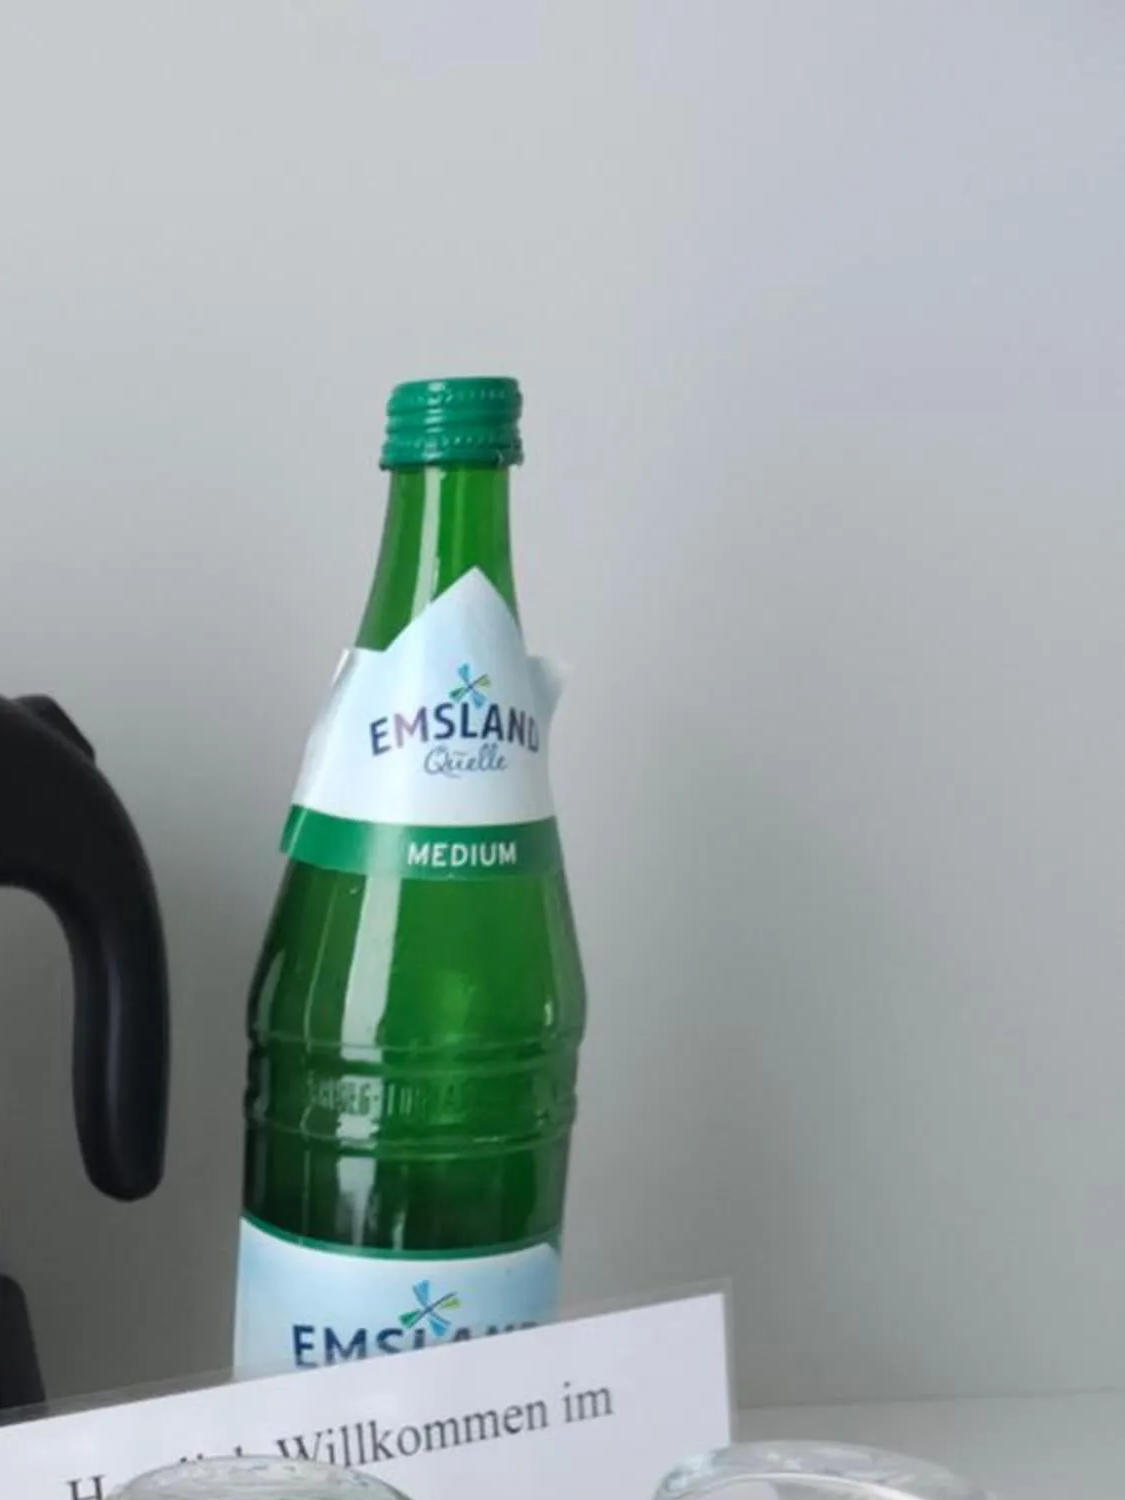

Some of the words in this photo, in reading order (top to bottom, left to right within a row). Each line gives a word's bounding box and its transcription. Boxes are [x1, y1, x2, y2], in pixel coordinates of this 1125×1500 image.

[369, 701, 540, 756] EMSLAND
[407, 842, 518, 866] MEDIUM
[292, 1323, 538, 1368] EMSL
[563, 1381, 615, 1424] im
